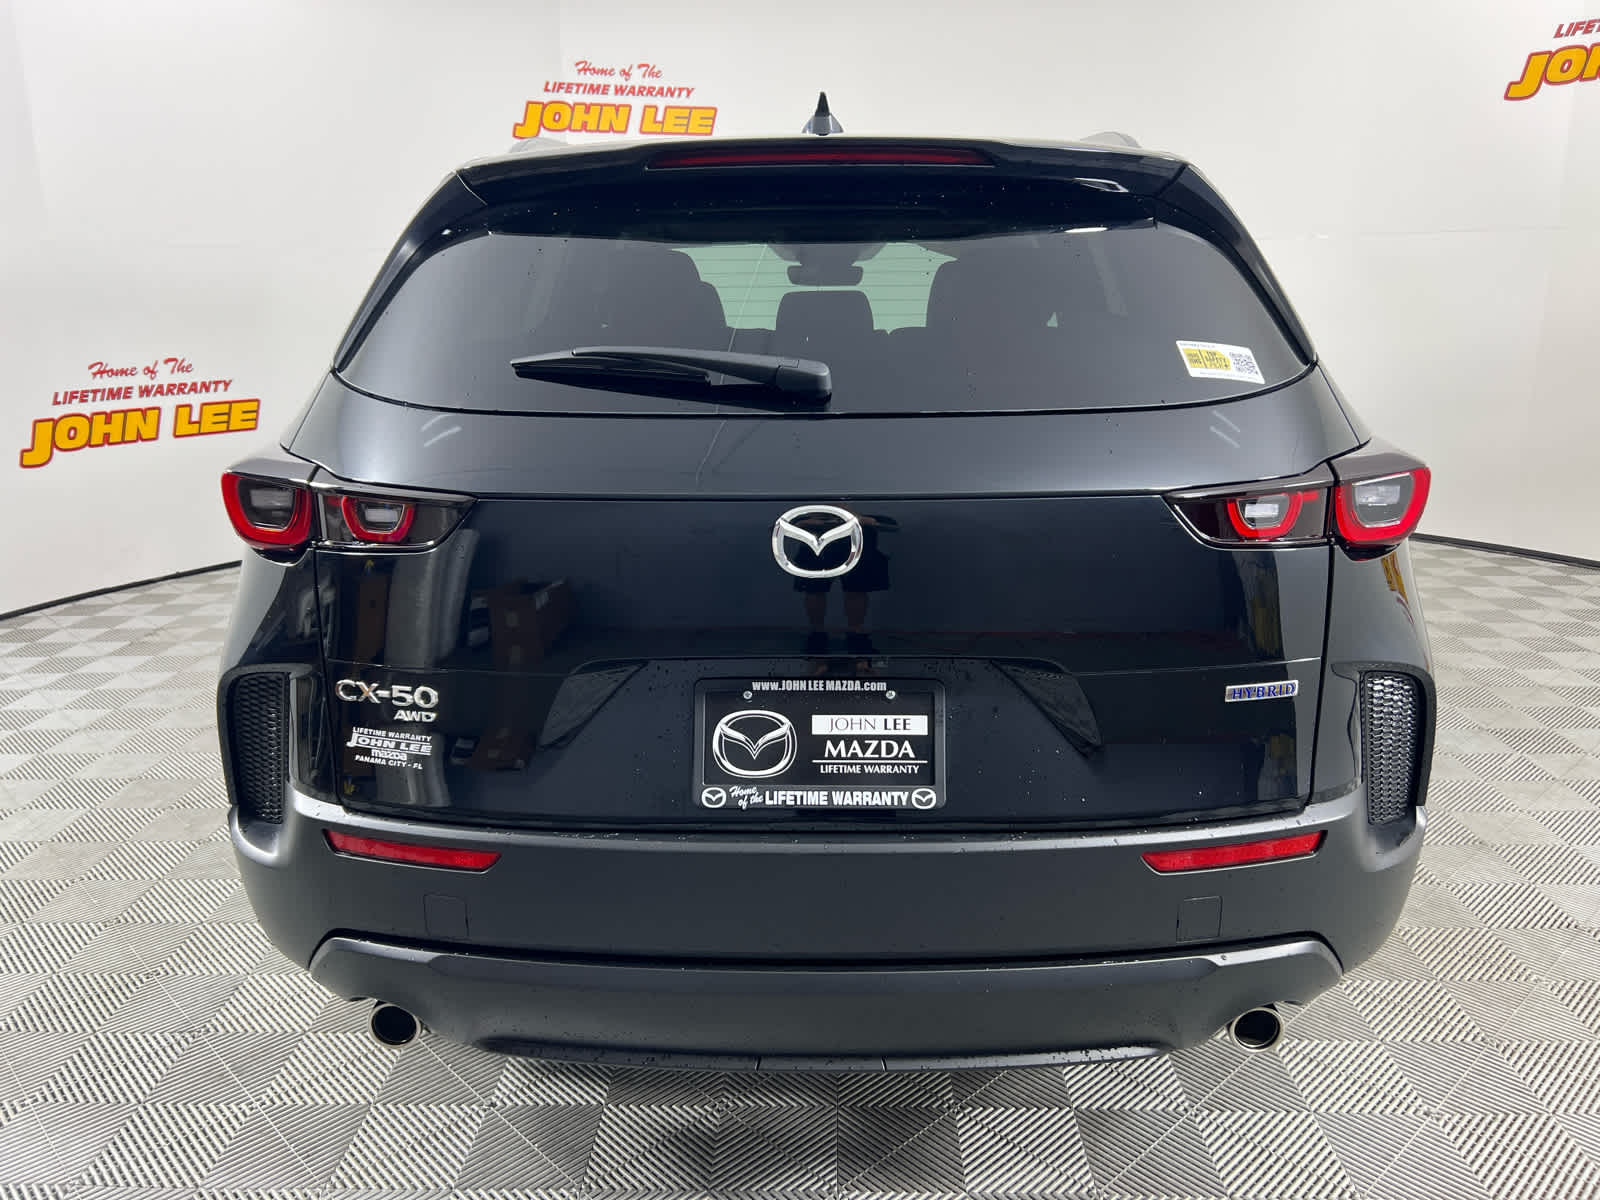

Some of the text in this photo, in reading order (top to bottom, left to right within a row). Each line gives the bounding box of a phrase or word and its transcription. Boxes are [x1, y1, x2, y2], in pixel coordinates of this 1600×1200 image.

[575, 60, 663, 81] Home of The
[543, 81, 695, 98] LIFETIME WARRANTY
[512, 100, 718, 139] JOHN LEE
[88, 357, 193, 380] Home of The
[52, 379, 232, 406] LIFETIME WARRANTY
[19, 398, 261, 468] JOHN LEE
[335, 679, 439, 709] CX-50
[808, 681, 825, 691] LEE
[825, 680, 887, 692] MAZDA.com
[1231, 682, 1296, 700] HYBRID
[393, 709, 438, 722] AWD
[829, 717, 911, 732] JOHN LEE
[346, 732, 432, 753] JOHN LEE
[352, 726, 432, 742] LIFETIME WARRANTY
[371, 749, 407, 761] mazda
[824, 739, 915, 759] MAZDA
[355, 755, 386, 765] PANAMA
[388, 759, 407, 768] CITY
[412, 762, 423, 770] FL
[820, 764, 920, 774] LIFETIME WARRANTY
[729, 786, 758, 798] Home
[738, 791, 764, 810] of the
[765, 790, 909, 806] LIFETIME WARRANTY
